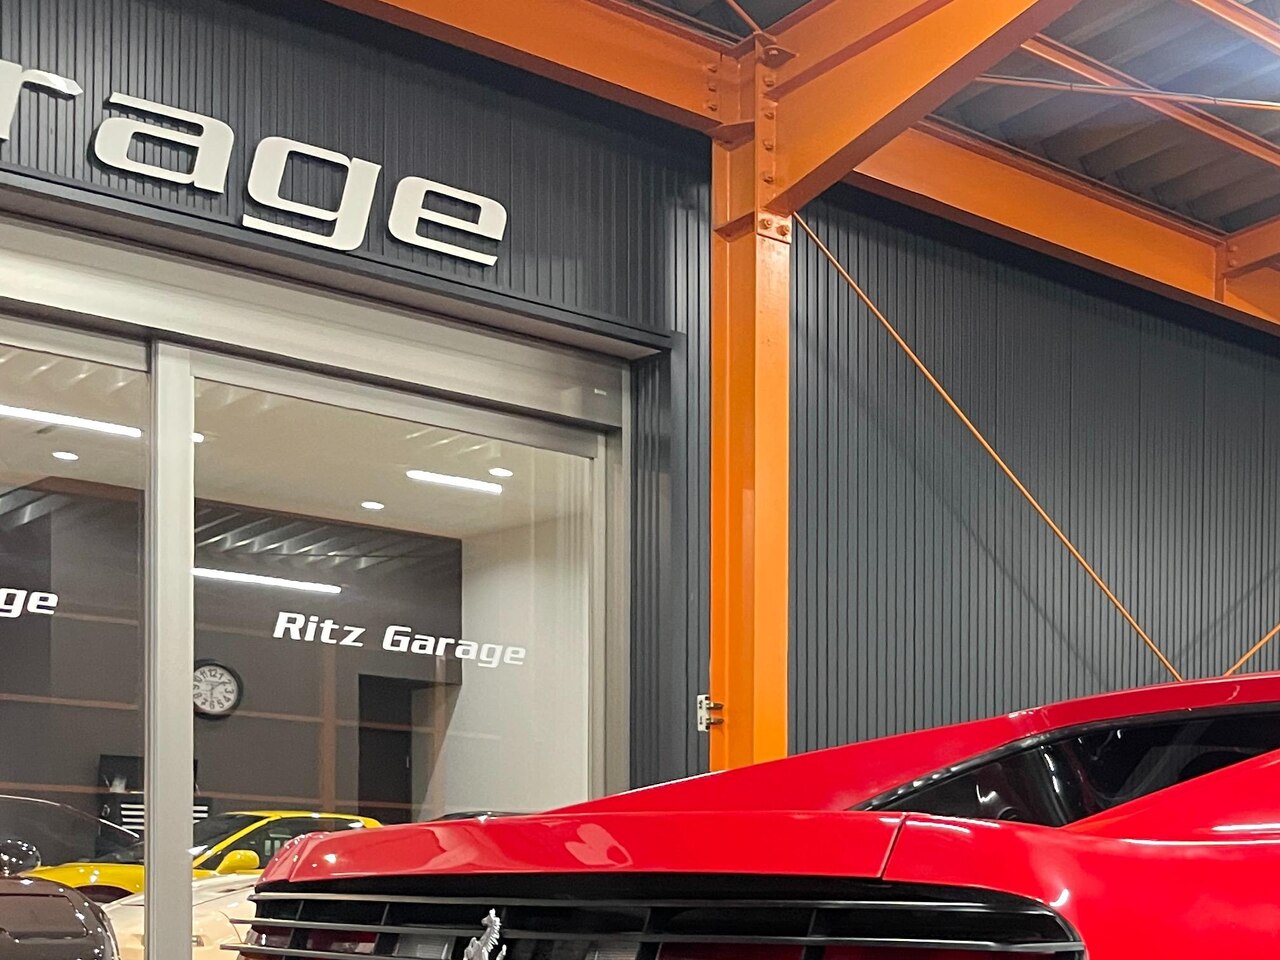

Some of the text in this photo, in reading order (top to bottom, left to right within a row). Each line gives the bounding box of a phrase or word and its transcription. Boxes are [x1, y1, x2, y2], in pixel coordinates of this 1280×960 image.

[0, 59, 507, 266] rage
[0, 588, 58, 618] ge
[273, 611, 526, 668] Ritz Garage
